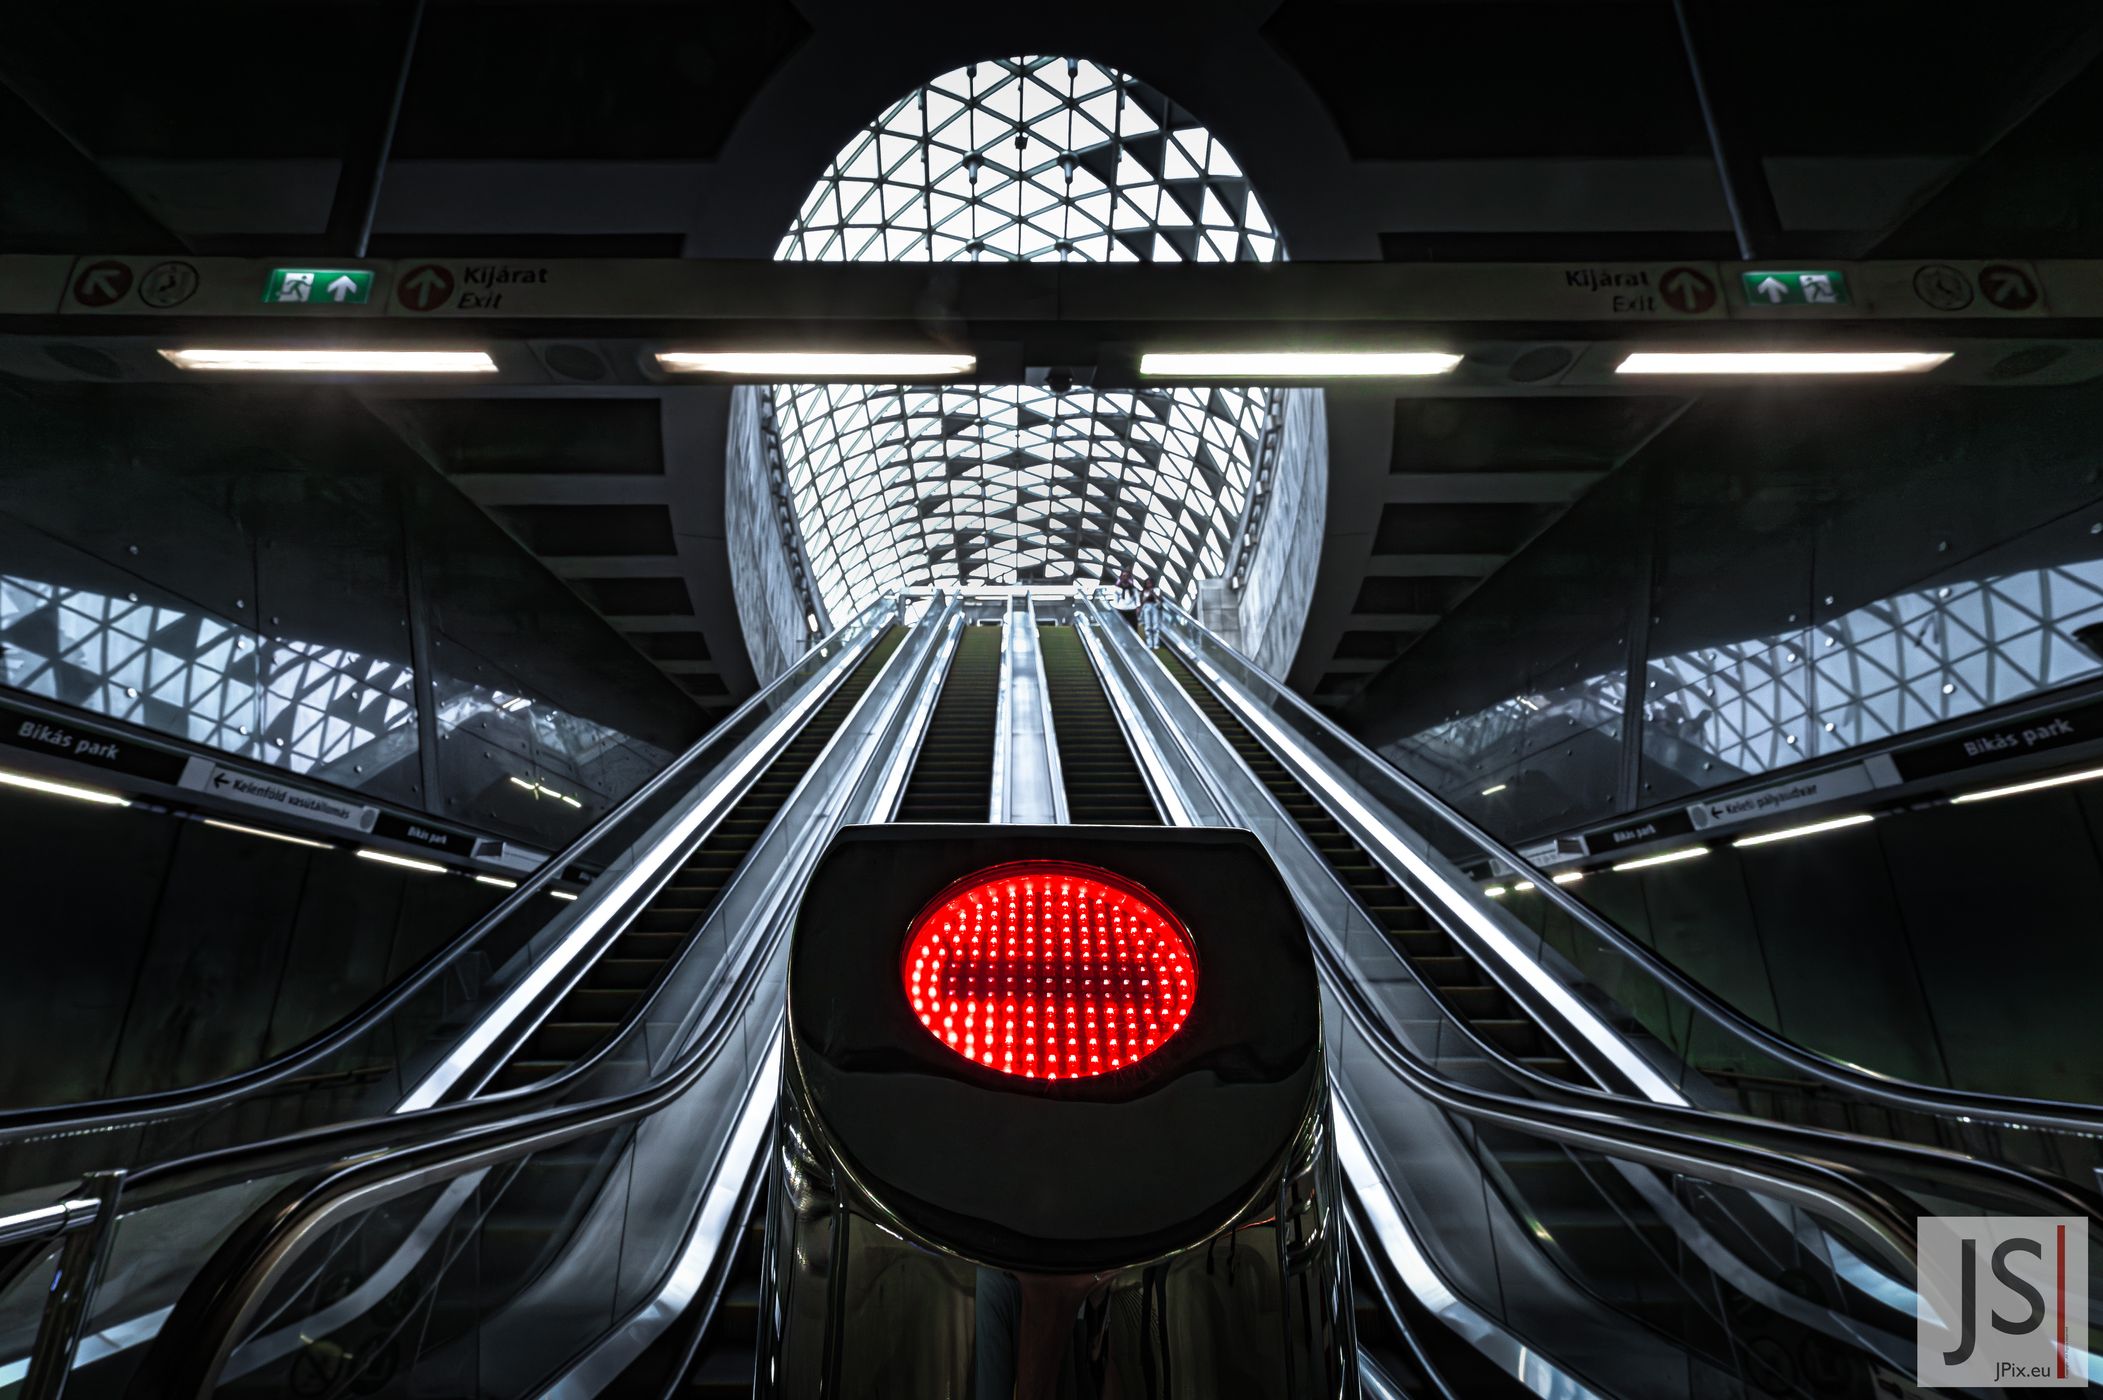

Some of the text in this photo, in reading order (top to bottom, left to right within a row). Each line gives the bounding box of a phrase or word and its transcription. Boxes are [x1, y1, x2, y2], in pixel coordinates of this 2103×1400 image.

[464, 265, 547, 289] Kijárat
[1565, 268, 1649, 292] Kijárat
[457, 292, 502, 309] Exit
[1613, 295, 1654, 313] Exit
[16, 719, 121, 761] Bikás park
[1963, 716, 2076, 757] Bikás park
